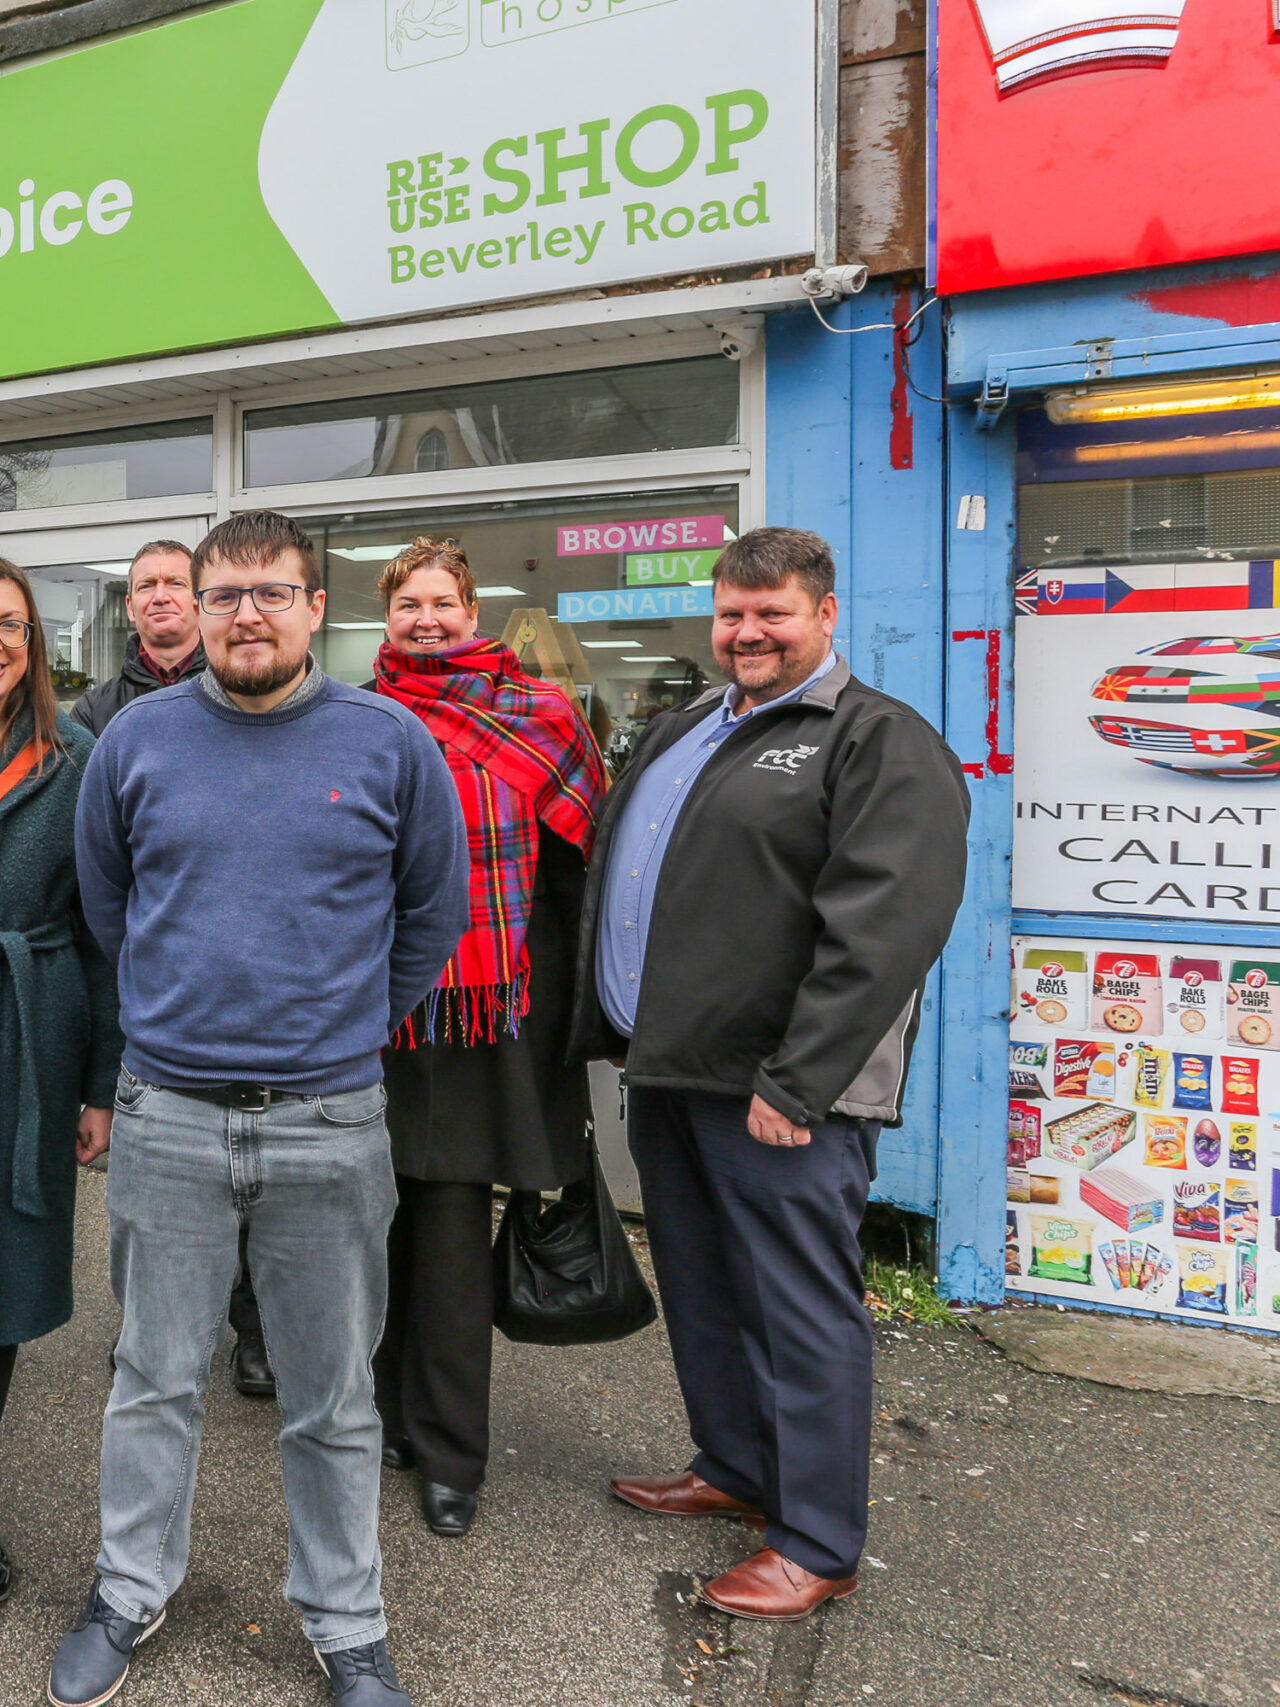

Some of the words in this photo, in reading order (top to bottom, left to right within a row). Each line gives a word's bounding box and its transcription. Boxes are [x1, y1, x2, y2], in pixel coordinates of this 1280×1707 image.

[482, 88, 769, 217] SHOP
[388, 185, 470, 233] USE
[388, 220, 605, 285] Beverley
[623, 181, 770, 246] Road
[563, 522, 707, 551] BROWSE.
[636, 555, 707, 580] BUY.
[565, 590, 707, 617] DONATE.
[757, 749, 808, 768] FCC
[753, 762, 797, 776] Environment
[1016, 802, 1277, 825] INTERNAT
[1058, 837, 1272, 868] CALLI
[1036, 985, 1068, 995] ROLLS
[1037, 978, 1067, 988] BAKE
[1107, 980, 1142, 990] BAGEL
[1109, 988, 1140, 997] CHIPS
[1180, 995, 1207, 1004] ROLLS
[1181, 988, 1205, 997] BAKE
[1240, 990, 1271, 1000] BAGEL
[1242, 998, 1269, 1007] CHIPS
[1056, 1056, 1092, 1076] Digestive
[1174, 1181, 1206, 1198] Viva
